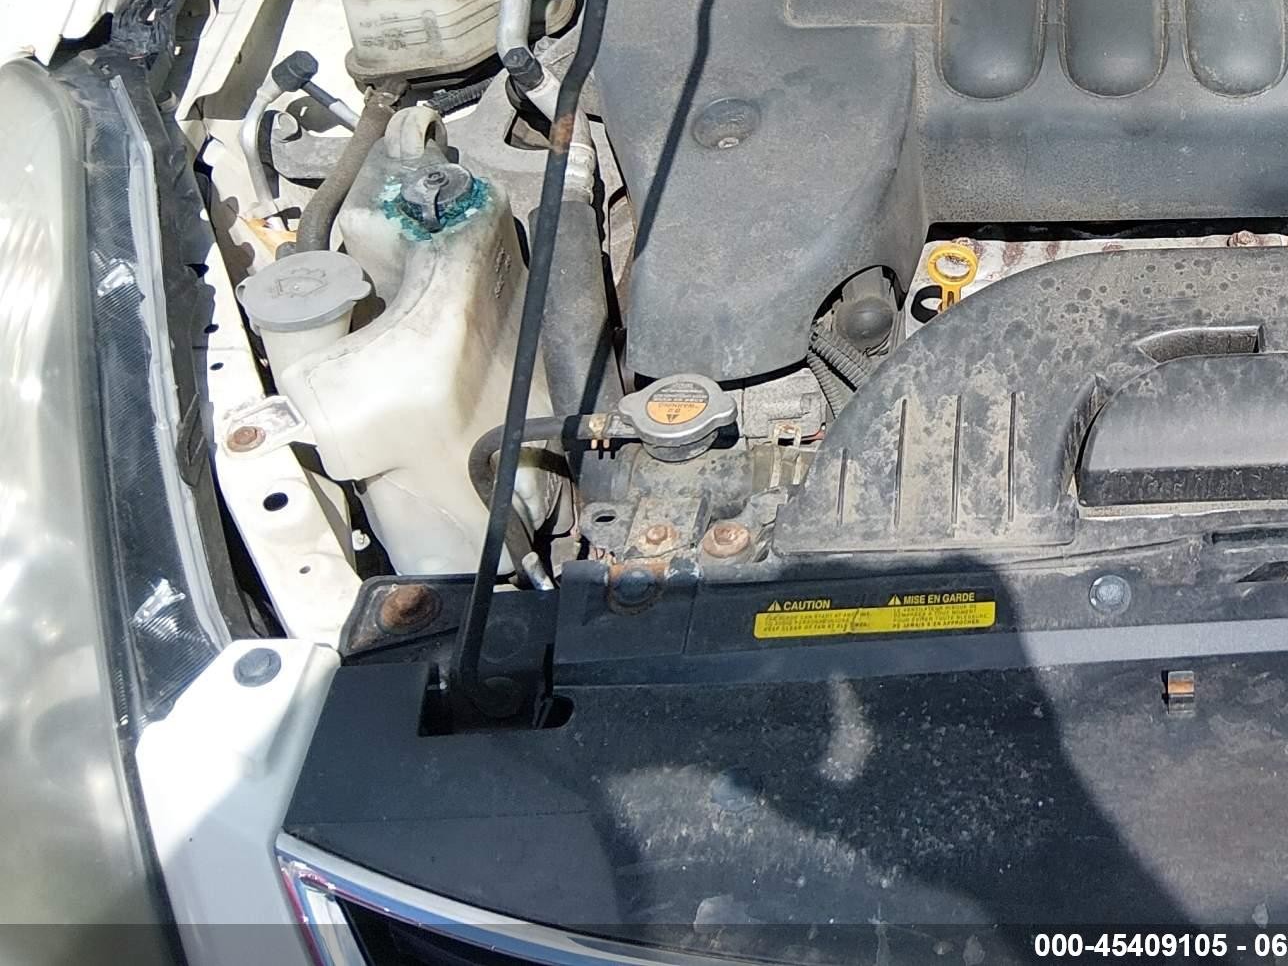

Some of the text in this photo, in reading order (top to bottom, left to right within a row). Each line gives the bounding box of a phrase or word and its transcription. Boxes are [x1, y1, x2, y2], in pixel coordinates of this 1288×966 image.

[903, 592, 975, 605] MISE EN GARDE
[783, 599, 831, 611] CAUTION
